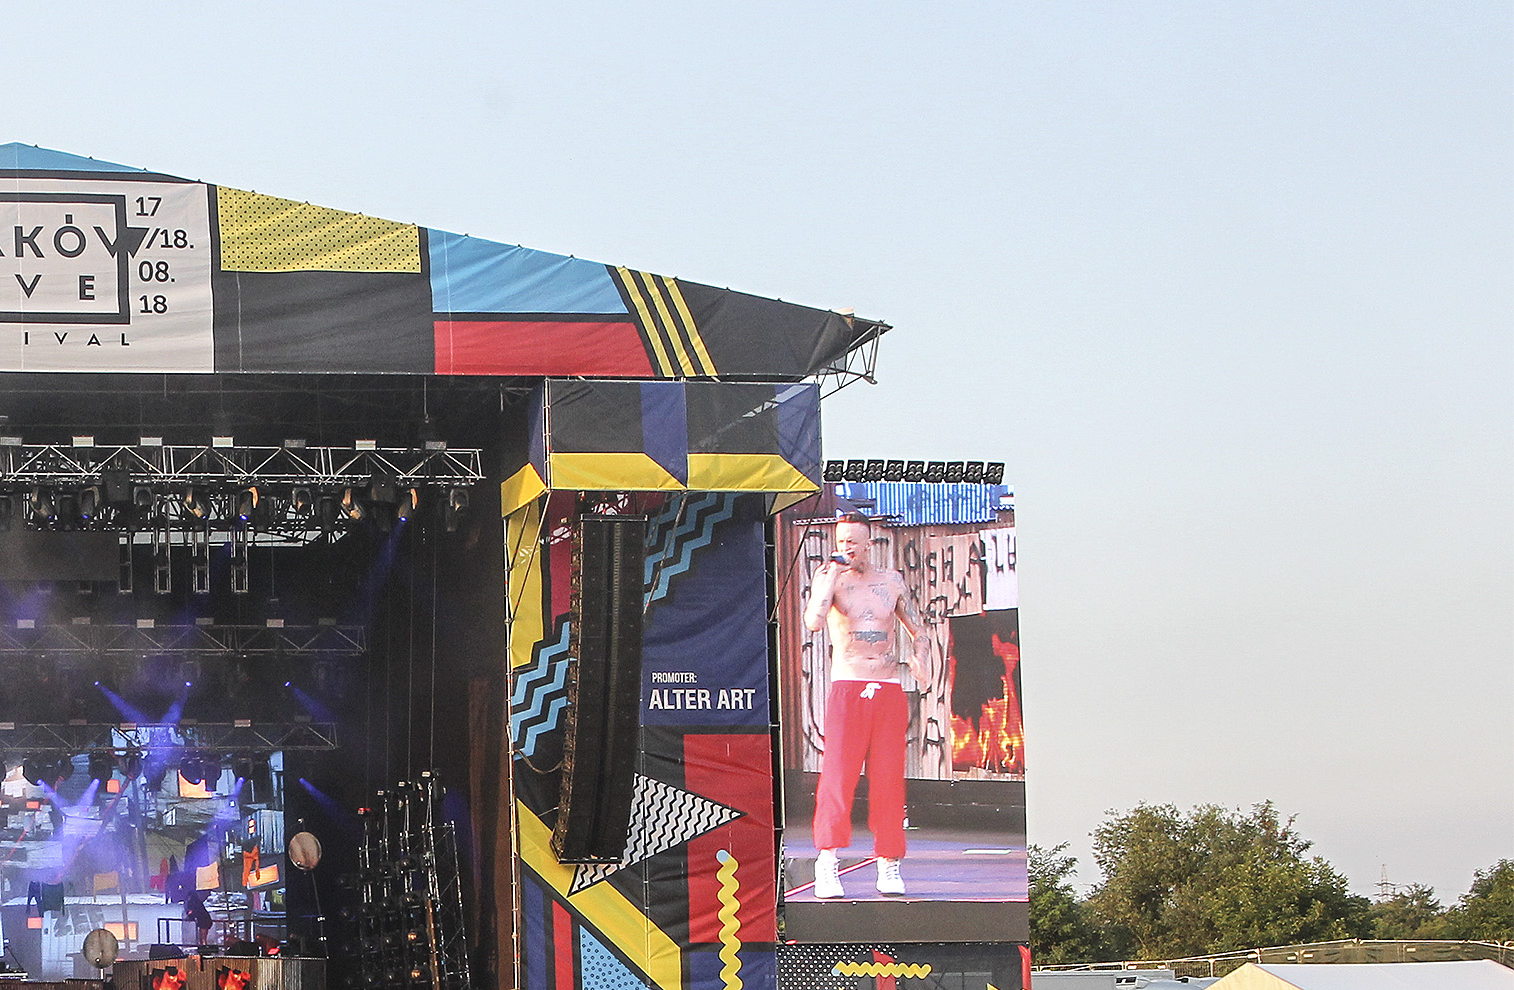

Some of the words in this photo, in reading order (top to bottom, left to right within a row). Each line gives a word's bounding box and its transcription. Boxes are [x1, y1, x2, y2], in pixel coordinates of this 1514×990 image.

[135, 197, 161, 217] 17
[138, 261, 175, 283] 08.
[139, 295, 167, 314] 18
[651, 672, 698, 683] PROMOTER:
[648, 689, 712, 710] ALTER
[716, 689, 756, 710] ART
